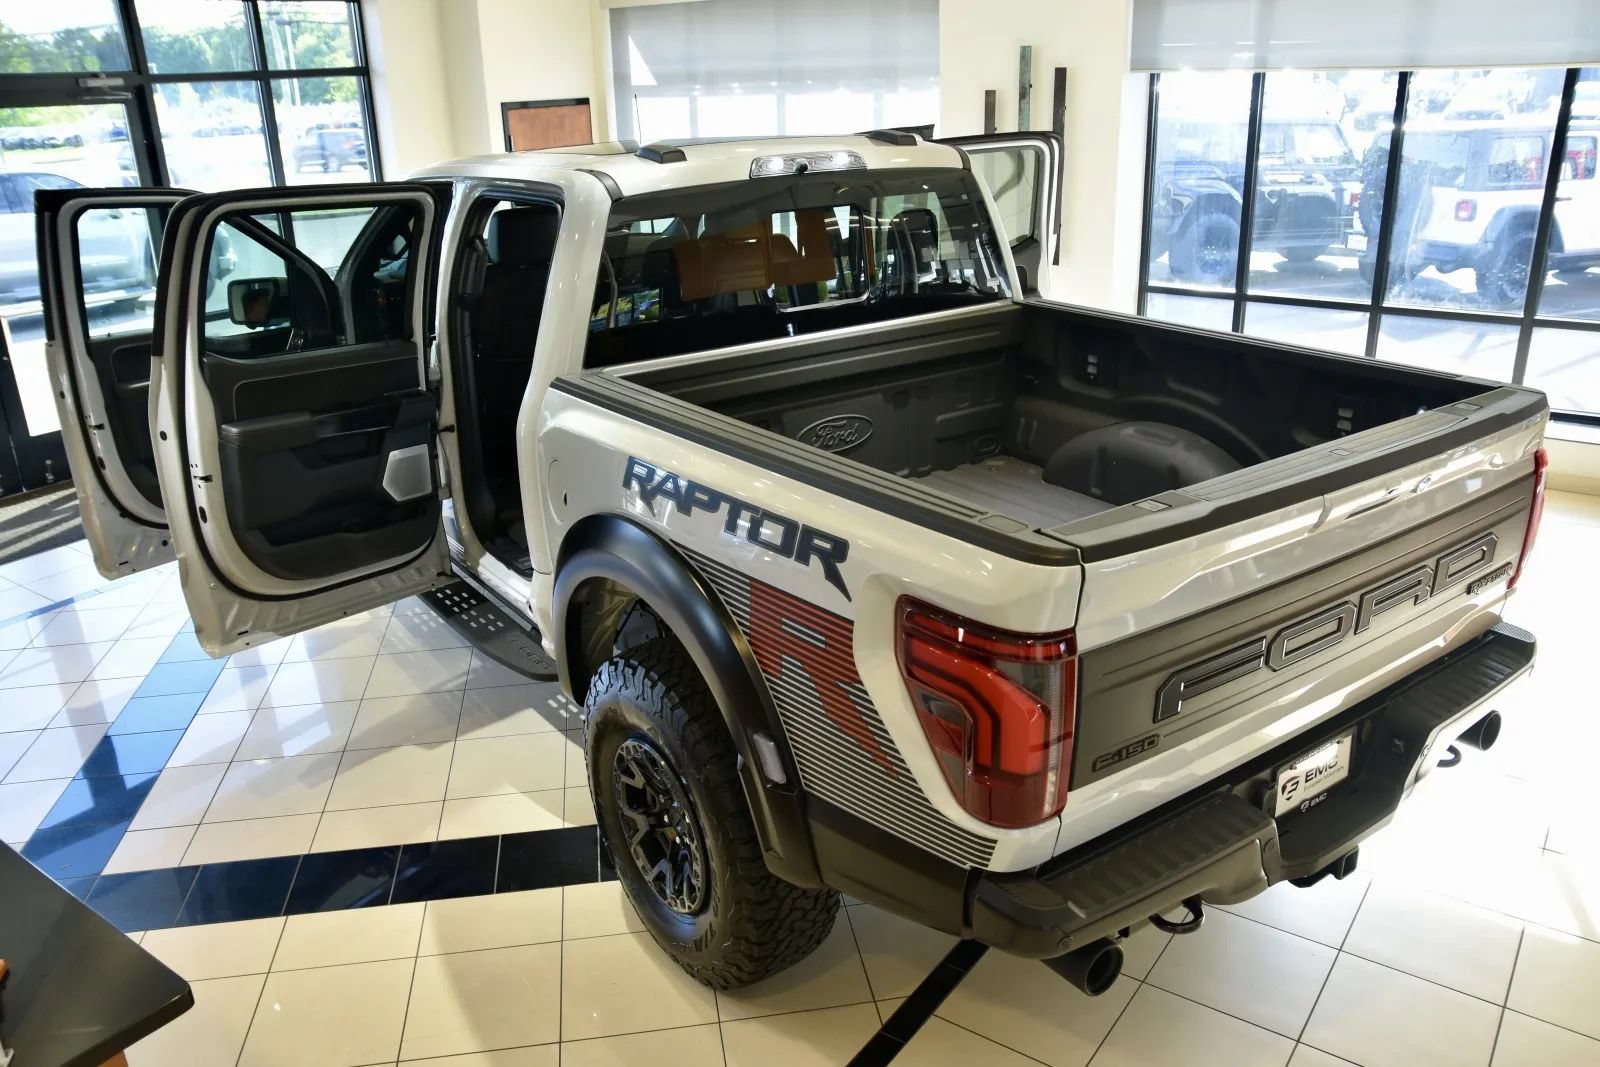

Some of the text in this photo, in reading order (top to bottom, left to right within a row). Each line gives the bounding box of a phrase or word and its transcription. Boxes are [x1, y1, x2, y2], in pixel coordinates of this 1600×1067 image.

[811, 420, 860, 448] Ford
[622, 455, 852, 603] RAPTOR
[1466, 561, 1513, 595] RAPTOR
[1153, 530, 1499, 724] FORD
[1304, 755, 1339, 784] EMC
[1310, 792, 1328, 807] EMC
